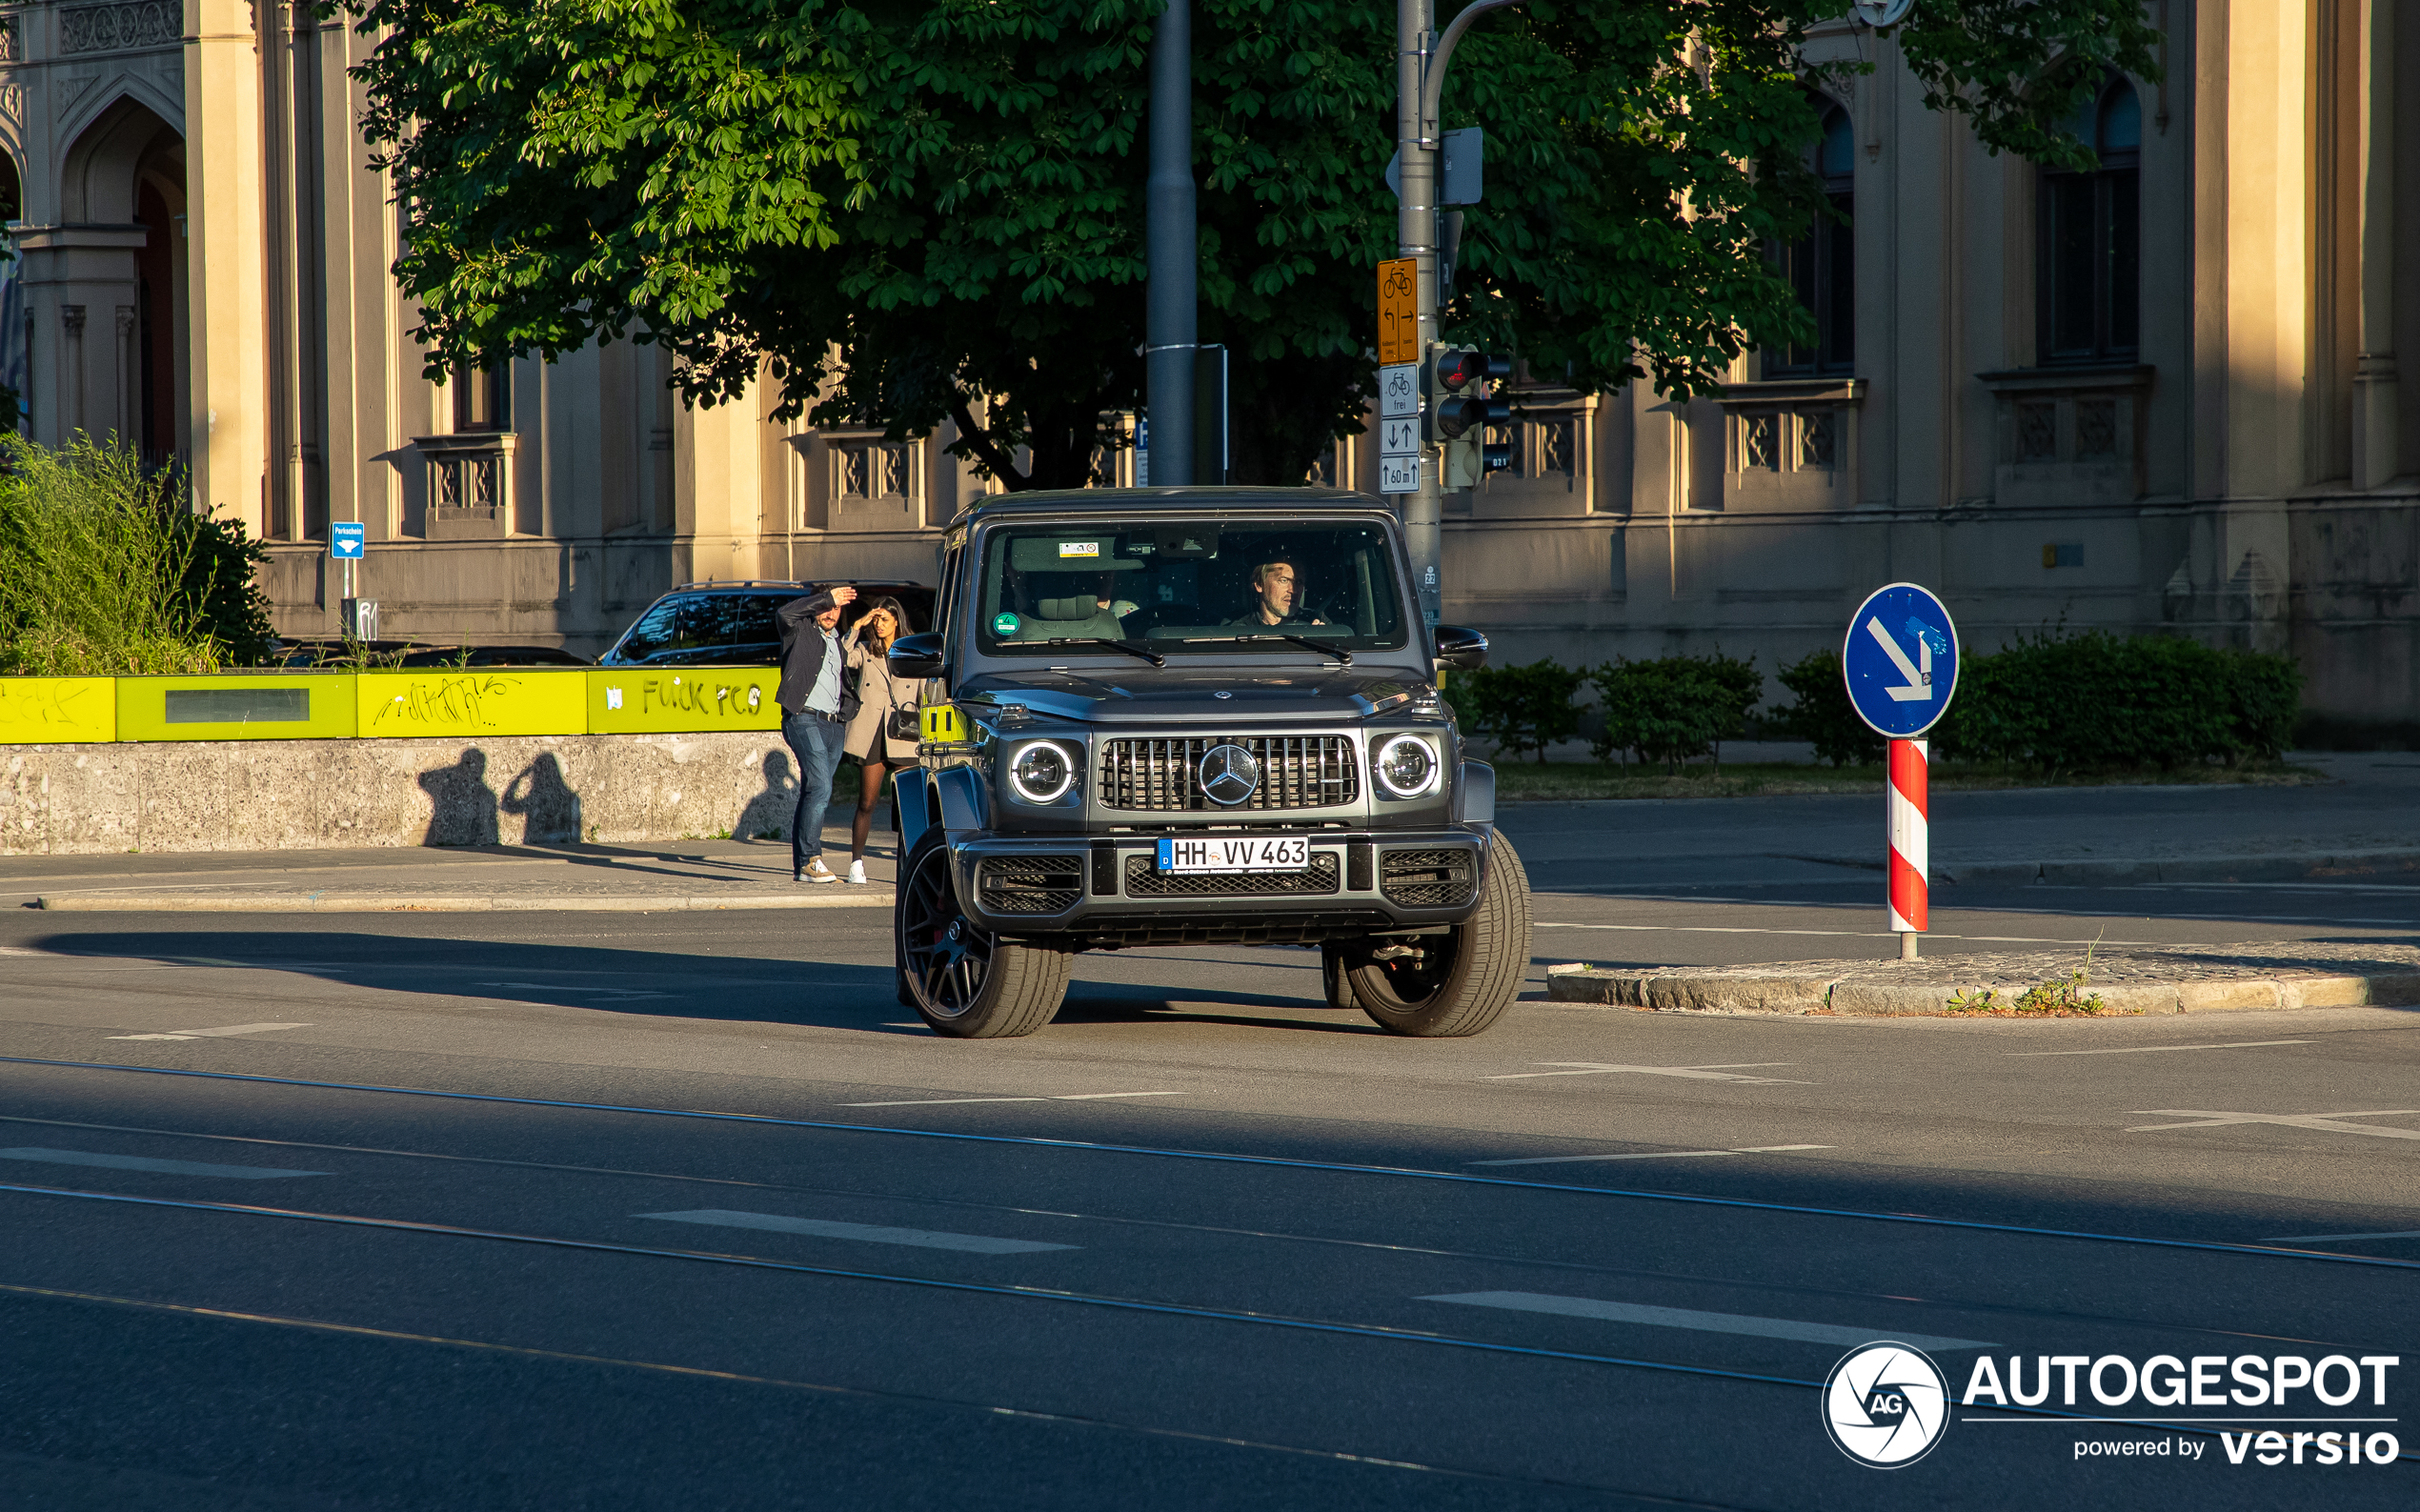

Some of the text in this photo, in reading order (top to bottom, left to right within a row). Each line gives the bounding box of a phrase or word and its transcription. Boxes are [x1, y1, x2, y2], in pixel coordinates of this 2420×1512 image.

[1394, 398, 1406, 411] frei
[1492, 458, 1507, 467] 021
[1391, 470, 1410, 484] 60 m
[334, 526, 362, 535] Parkschein
[1003, 615, 1010, 625] 4
[642, 677, 709, 715] FUCK
[1175, 840, 1305, 865] HH VV 463
